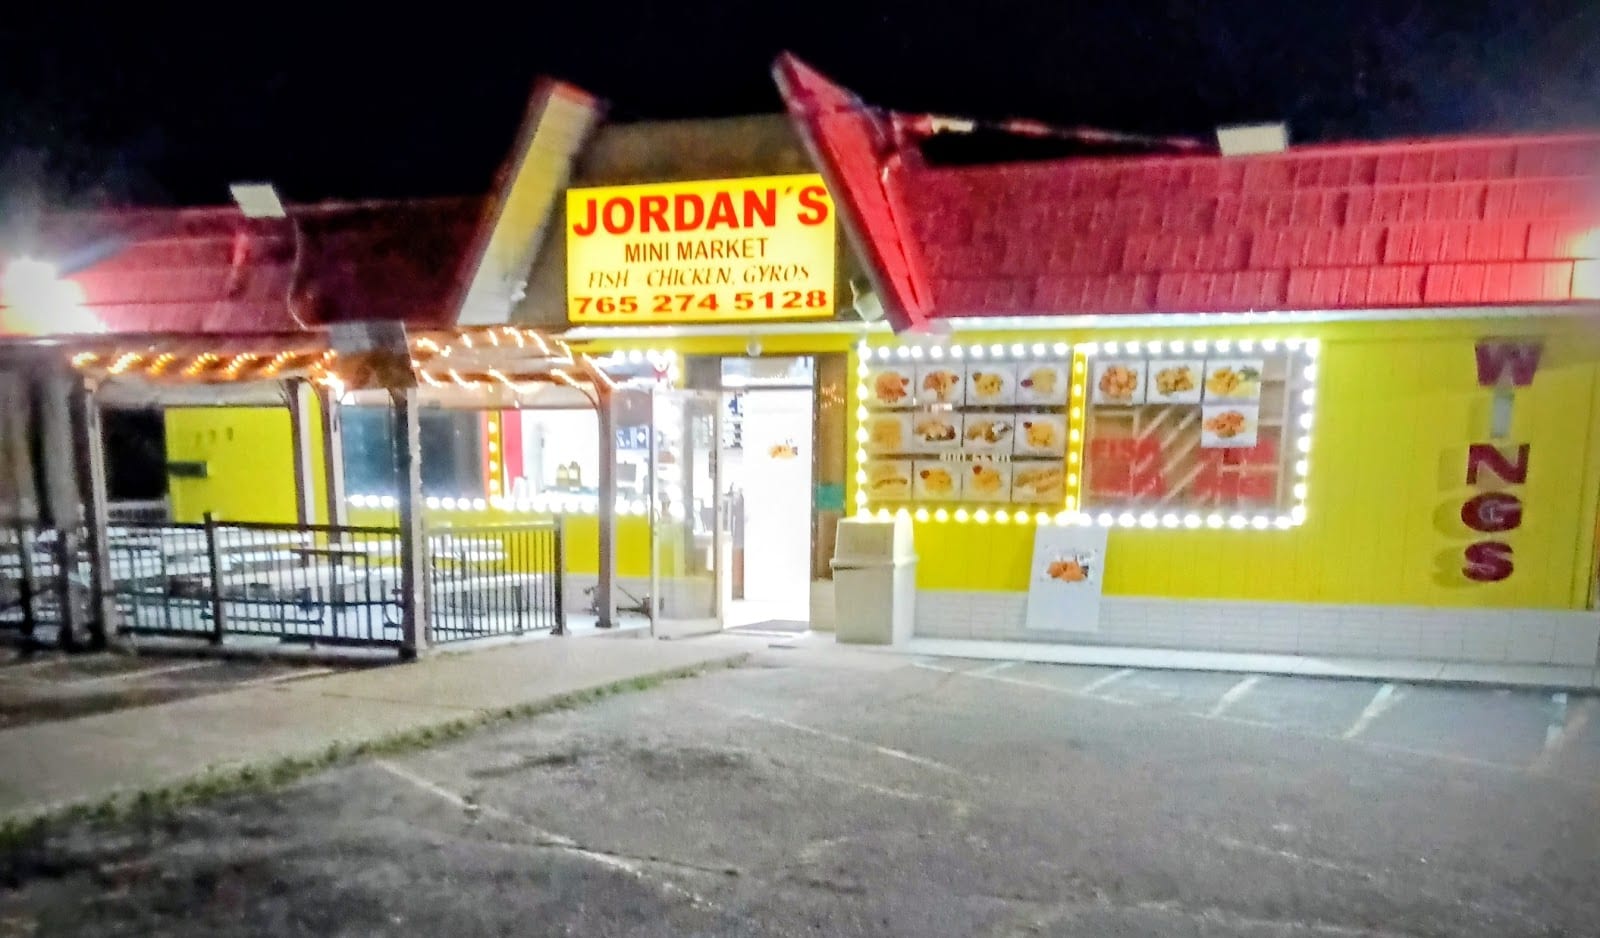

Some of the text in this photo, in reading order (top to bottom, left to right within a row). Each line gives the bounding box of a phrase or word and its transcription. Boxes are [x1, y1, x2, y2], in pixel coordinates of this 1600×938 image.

[573, 185, 828, 236] JORDAN'S
[625, 238, 768, 263] MINI MARKET
[588, 268, 629, 289] FISH
[743, 264, 809, 283] GYROS
[574, 290, 827, 315] 765 274 5128
[1461, 341, 1544, 582] WINGS
